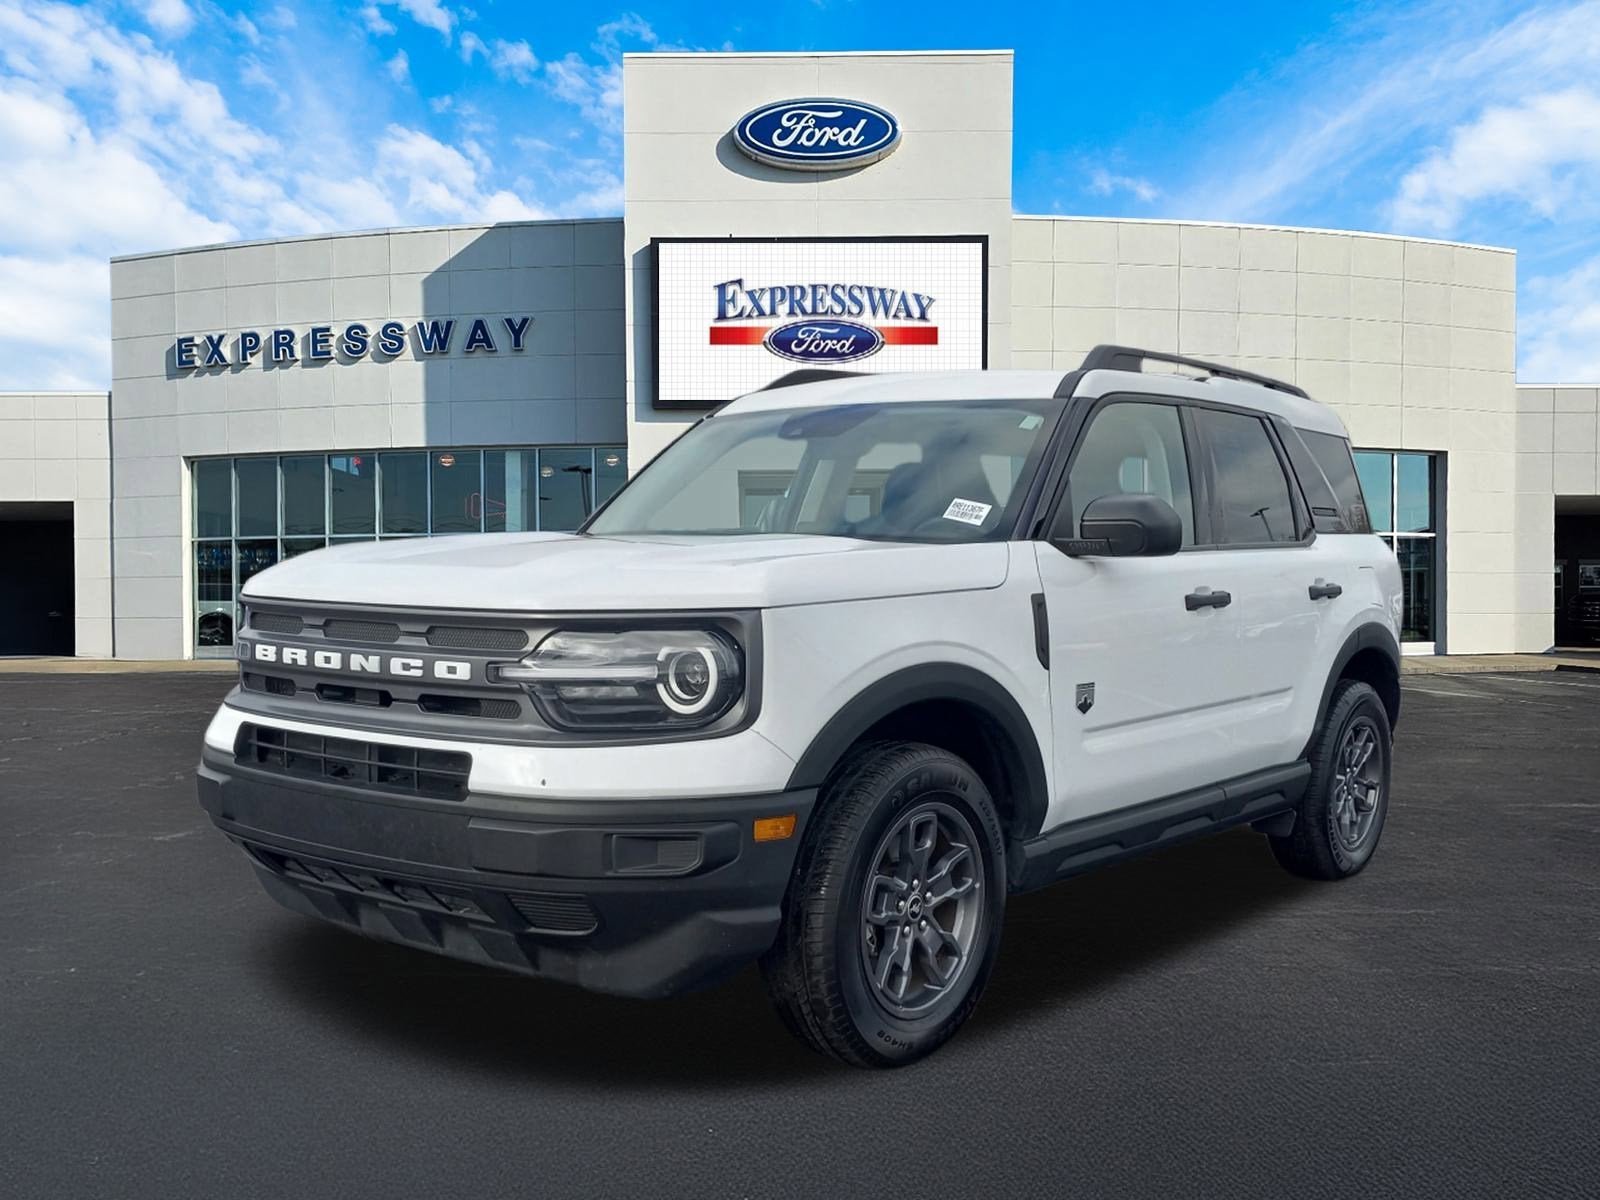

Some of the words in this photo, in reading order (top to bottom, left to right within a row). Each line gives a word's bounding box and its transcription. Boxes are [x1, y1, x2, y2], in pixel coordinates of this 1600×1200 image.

[772, 110, 867, 147] Ford
[713, 278, 935, 322] EXPRESSWAY
[176, 316, 532, 368] EXPRESSWAY
[791, 326, 855, 353] Ford
[255, 643, 472, 681] BRONCO
